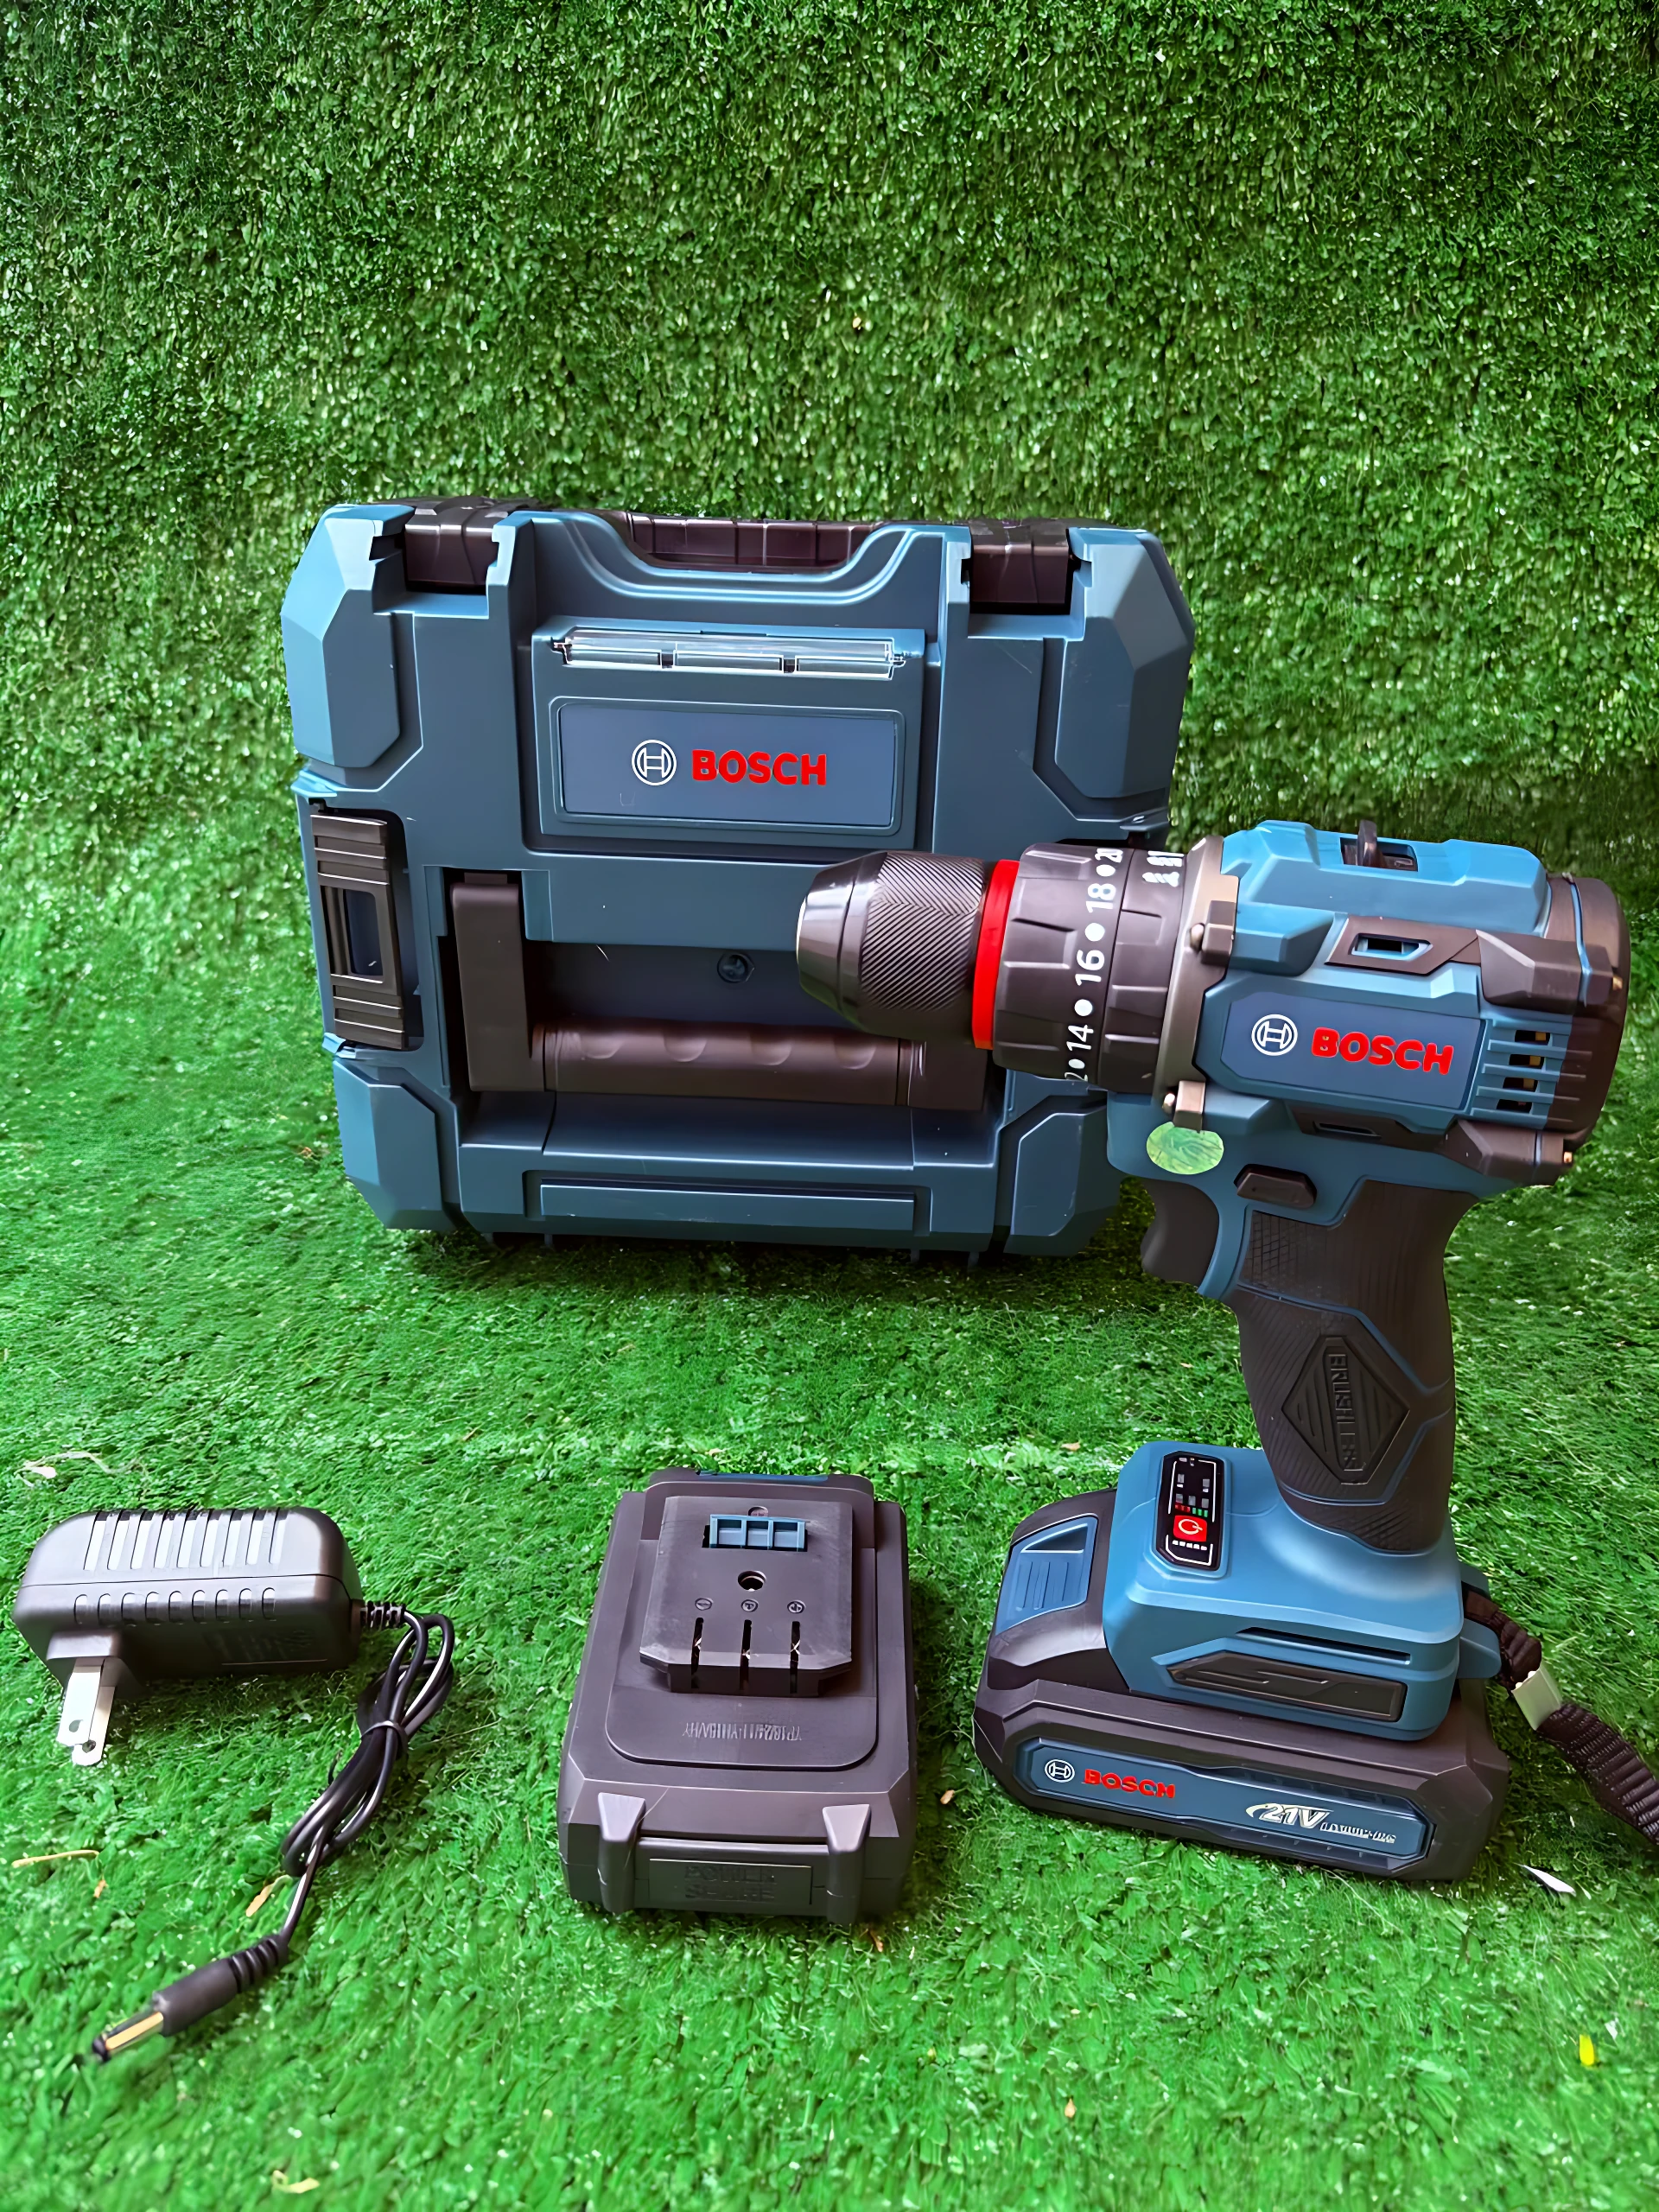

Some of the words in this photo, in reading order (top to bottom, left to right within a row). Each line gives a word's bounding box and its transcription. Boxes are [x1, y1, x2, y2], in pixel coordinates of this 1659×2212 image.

[692, 749, 827, 785] BOSCH
[1085, 882, 1117, 913] 18
[1075, 949, 1105, 986] 16
[1066, 1024, 1094, 1052] 14
[1311, 1027, 1454, 1075] BOSCH
[1329, 1354, 1357, 1468] BRUSHL
[1084, 1769, 1176, 1799] BOSCH
[1258, 1803, 1332, 1829] 21V
